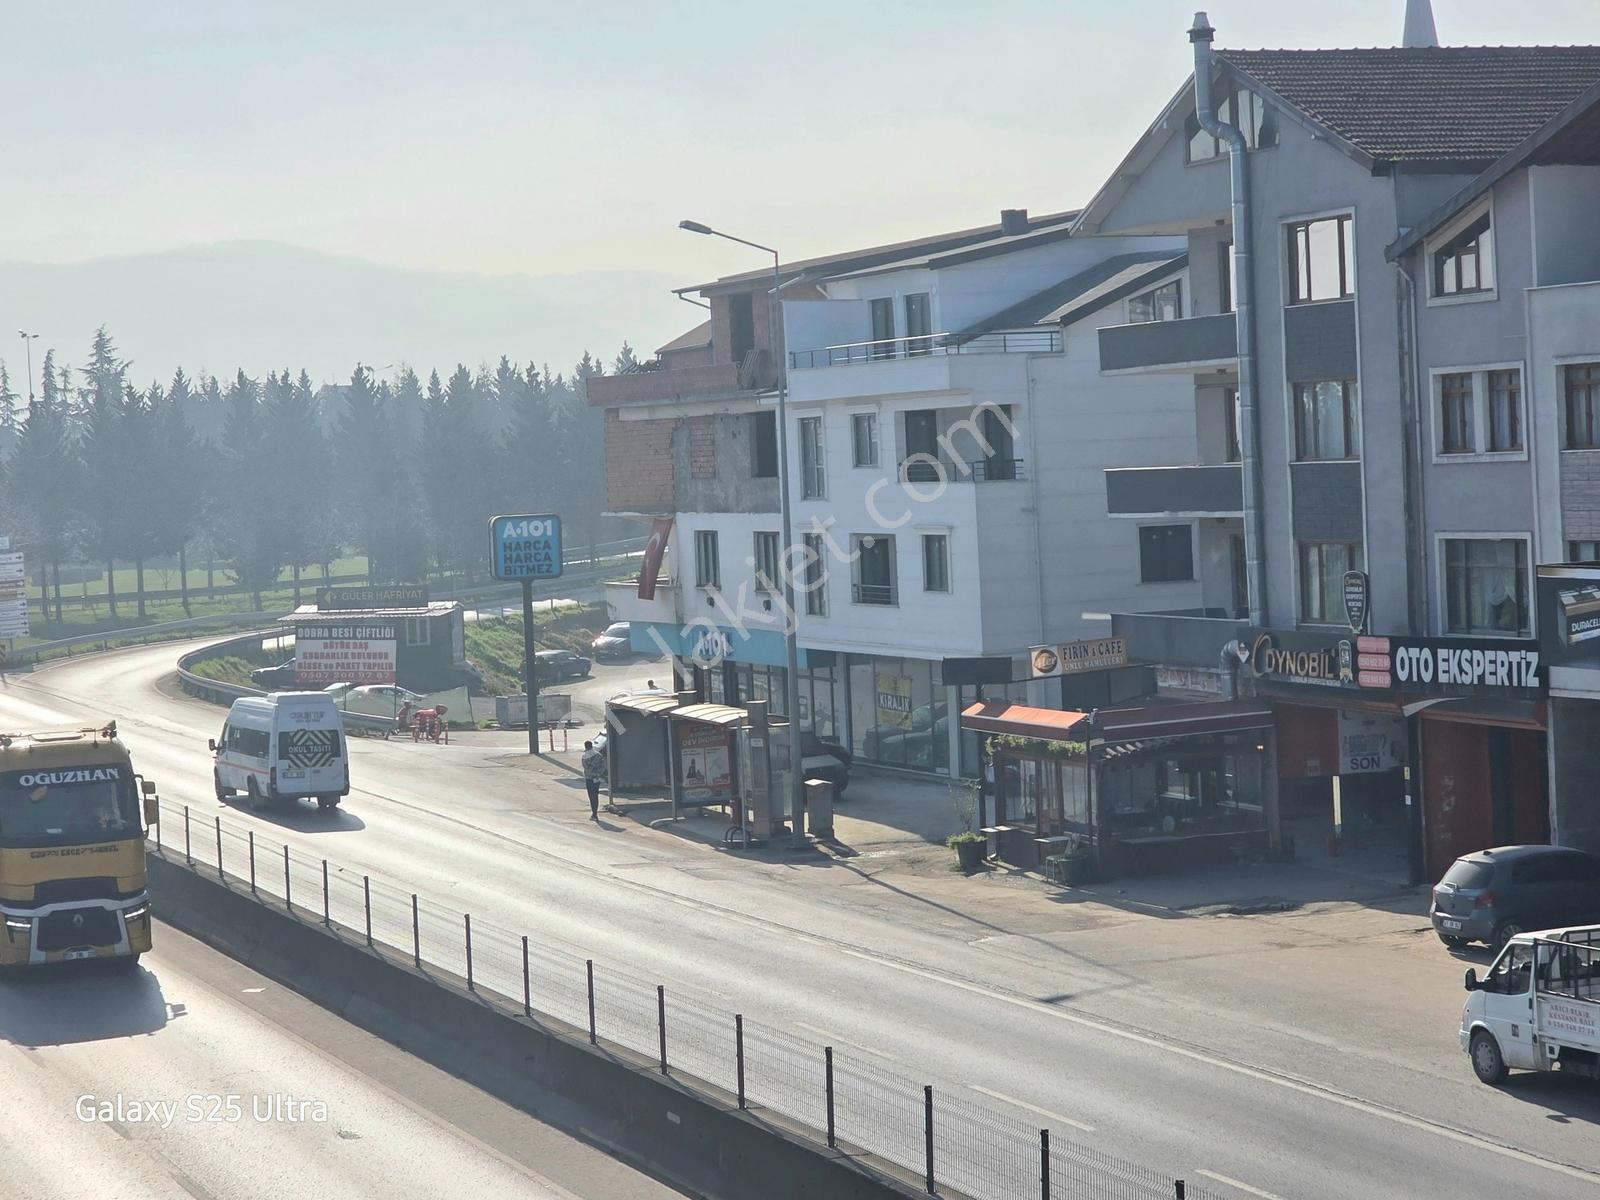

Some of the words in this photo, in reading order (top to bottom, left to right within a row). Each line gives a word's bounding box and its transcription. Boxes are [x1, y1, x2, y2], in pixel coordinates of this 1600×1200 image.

[503, 540, 552, 552] HARCA
[504, 552, 552, 564] HARCA
[331, 627, 353, 638] BESİ
[355, 626, 395, 639] ÇİFTLİĞİ
[1098, 640, 1122, 656] CAFE
[335, 661, 360, 670] PAKET
[1395, 646, 1434, 683] OTO
[1437, 648, 1540, 688] EKSPERTİZ
[880, 693, 910, 711] KIRALIK
[288, 745, 308, 753] OKUL
[1350, 756, 1381, 770] SON
